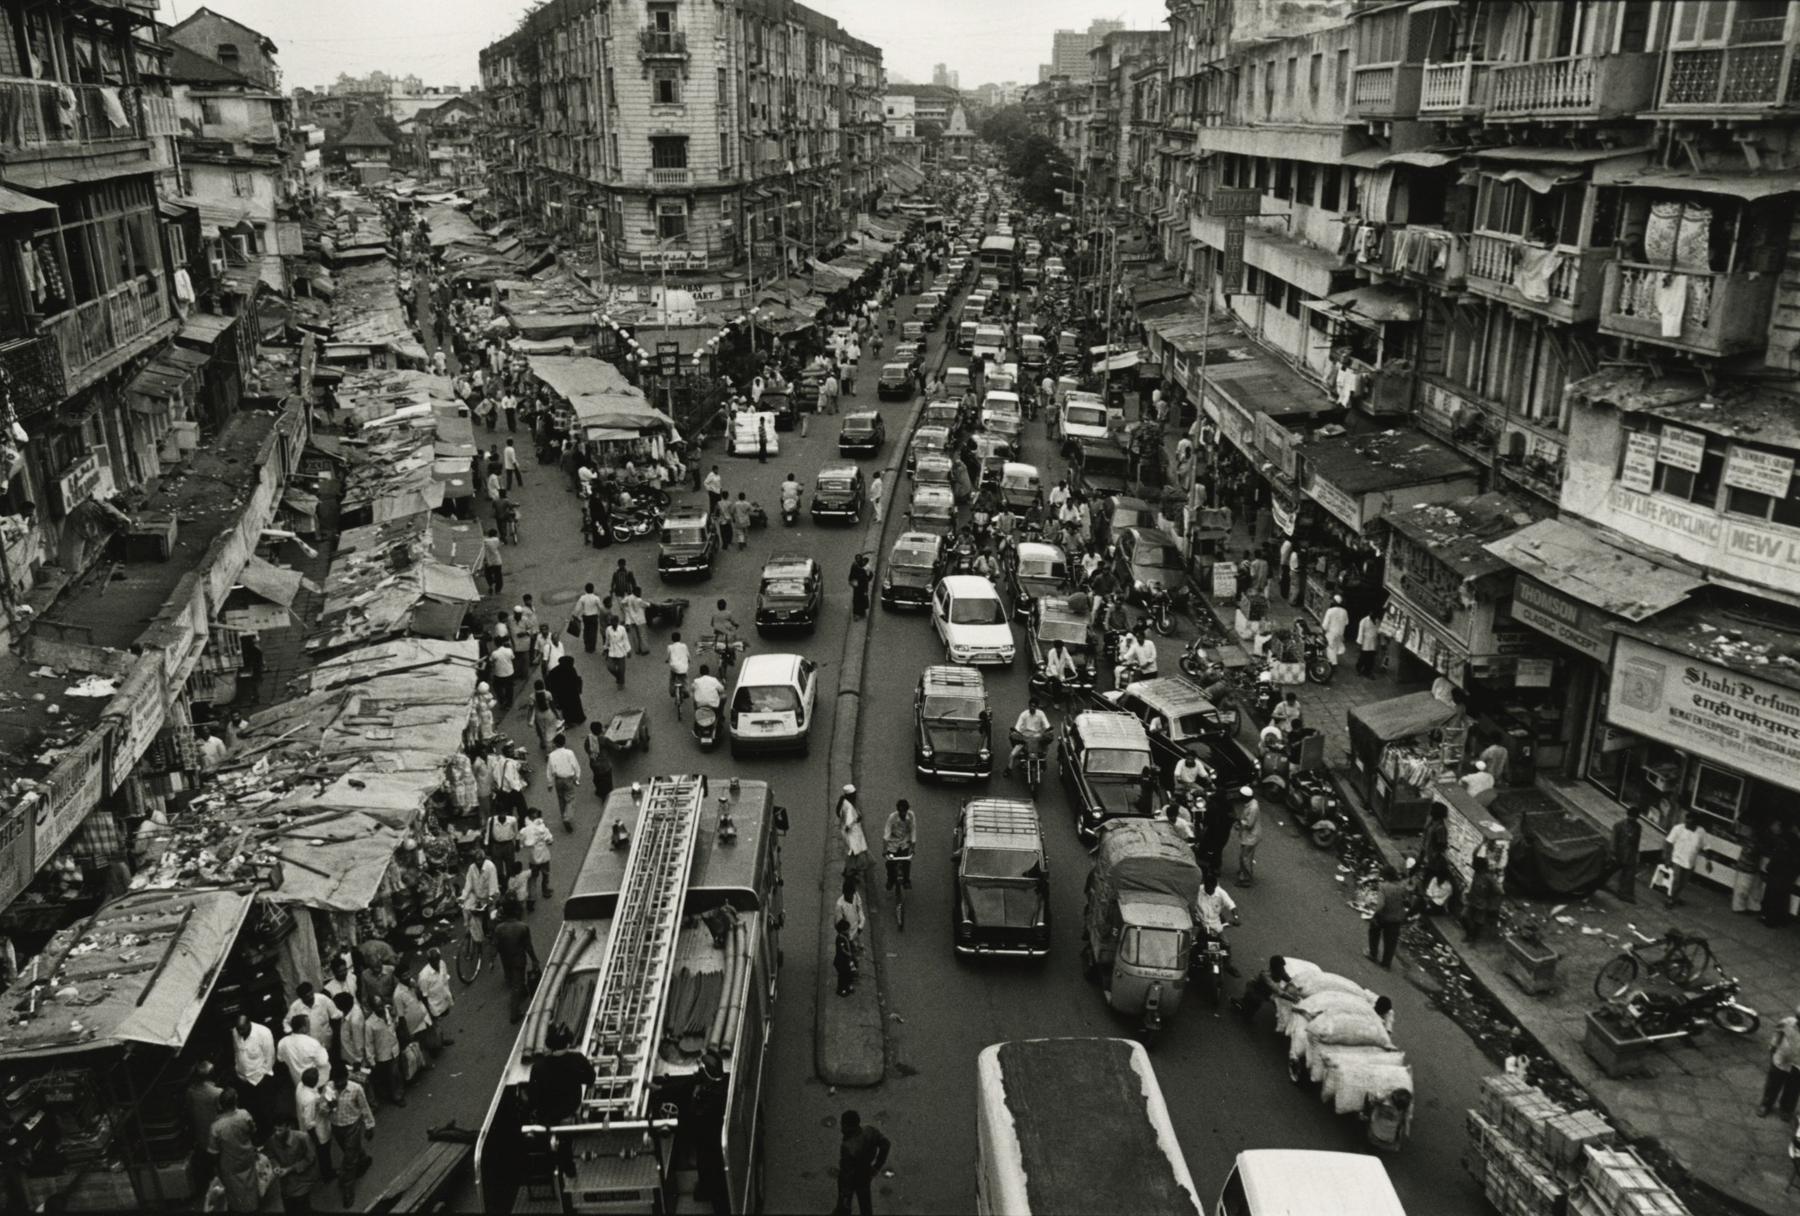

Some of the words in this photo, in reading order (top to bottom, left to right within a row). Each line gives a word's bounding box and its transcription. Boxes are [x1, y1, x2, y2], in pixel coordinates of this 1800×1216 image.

[1634, 496, 1659, 520] LIFE
[1658, 505, 1719, 541] POLYCLINIC
[1731, 529, 1783, 558] NEW
[1785, 543, 1800, 566] L
[1519, 582, 1578, 623] THOMSON
[1523, 608, 1556, 632] CLASSIC
[1559, 626, 1599, 652] CONCEPT
[1682, 667, 1736, 696] Shahi
[1692, 694, 1732, 716] शाही
[1692, 713, 1740, 739] ENTERPRISES
